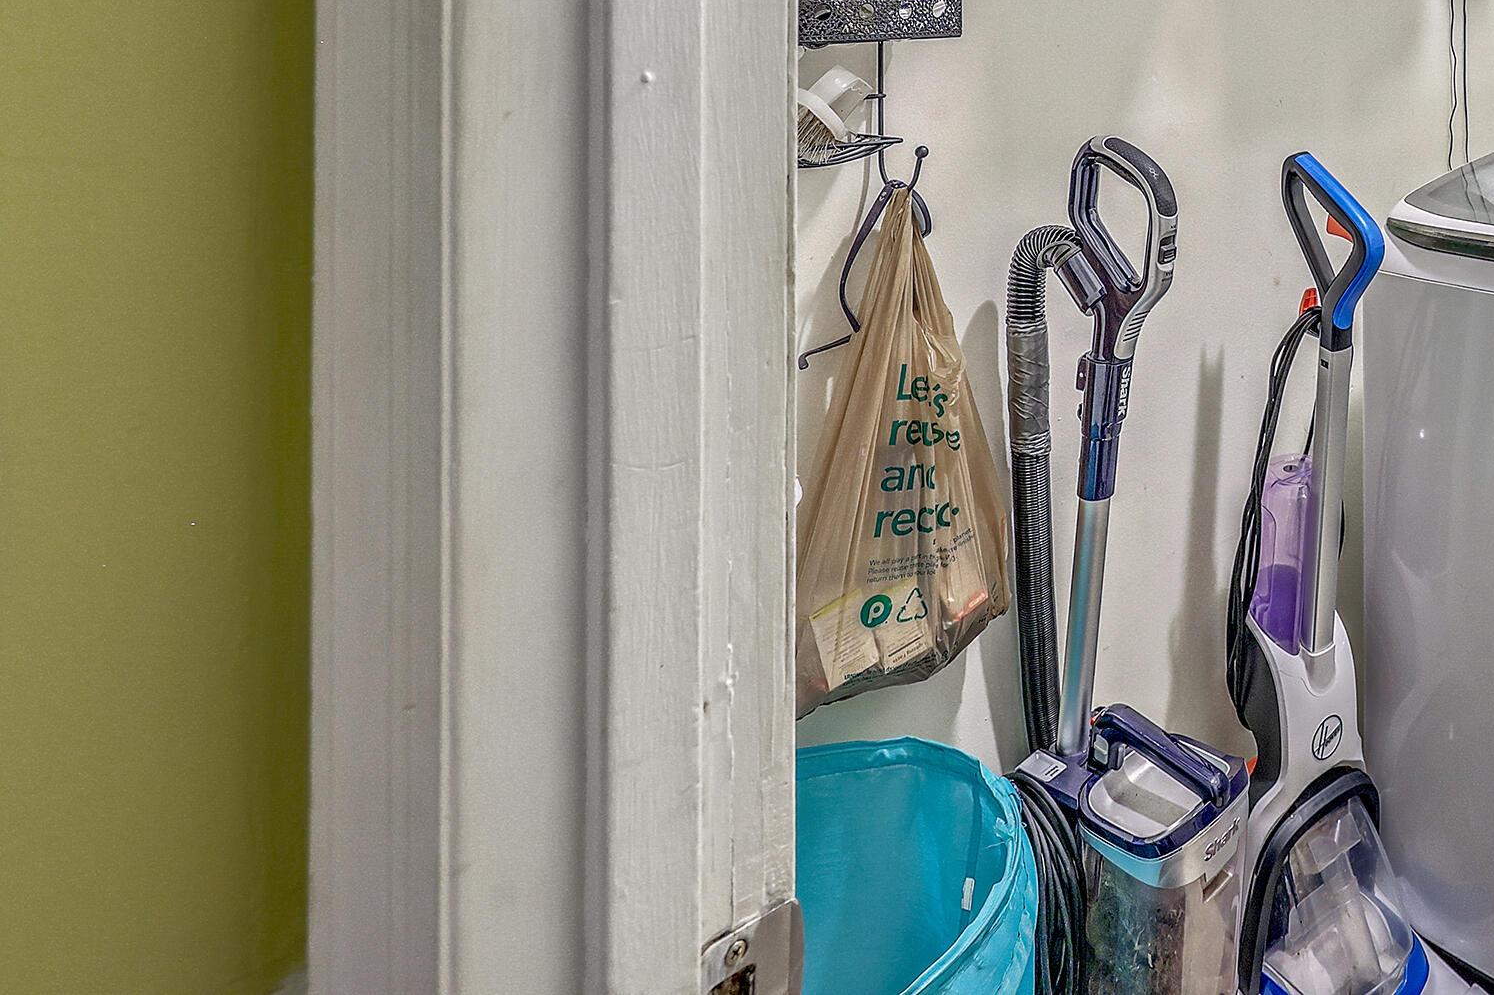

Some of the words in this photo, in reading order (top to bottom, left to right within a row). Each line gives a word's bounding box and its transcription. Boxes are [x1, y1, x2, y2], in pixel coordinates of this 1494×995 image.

[1117, 366, 1131, 418] Shark
[889, 419, 961, 451] reuse
[1203, 816, 1240, 862] Shark
